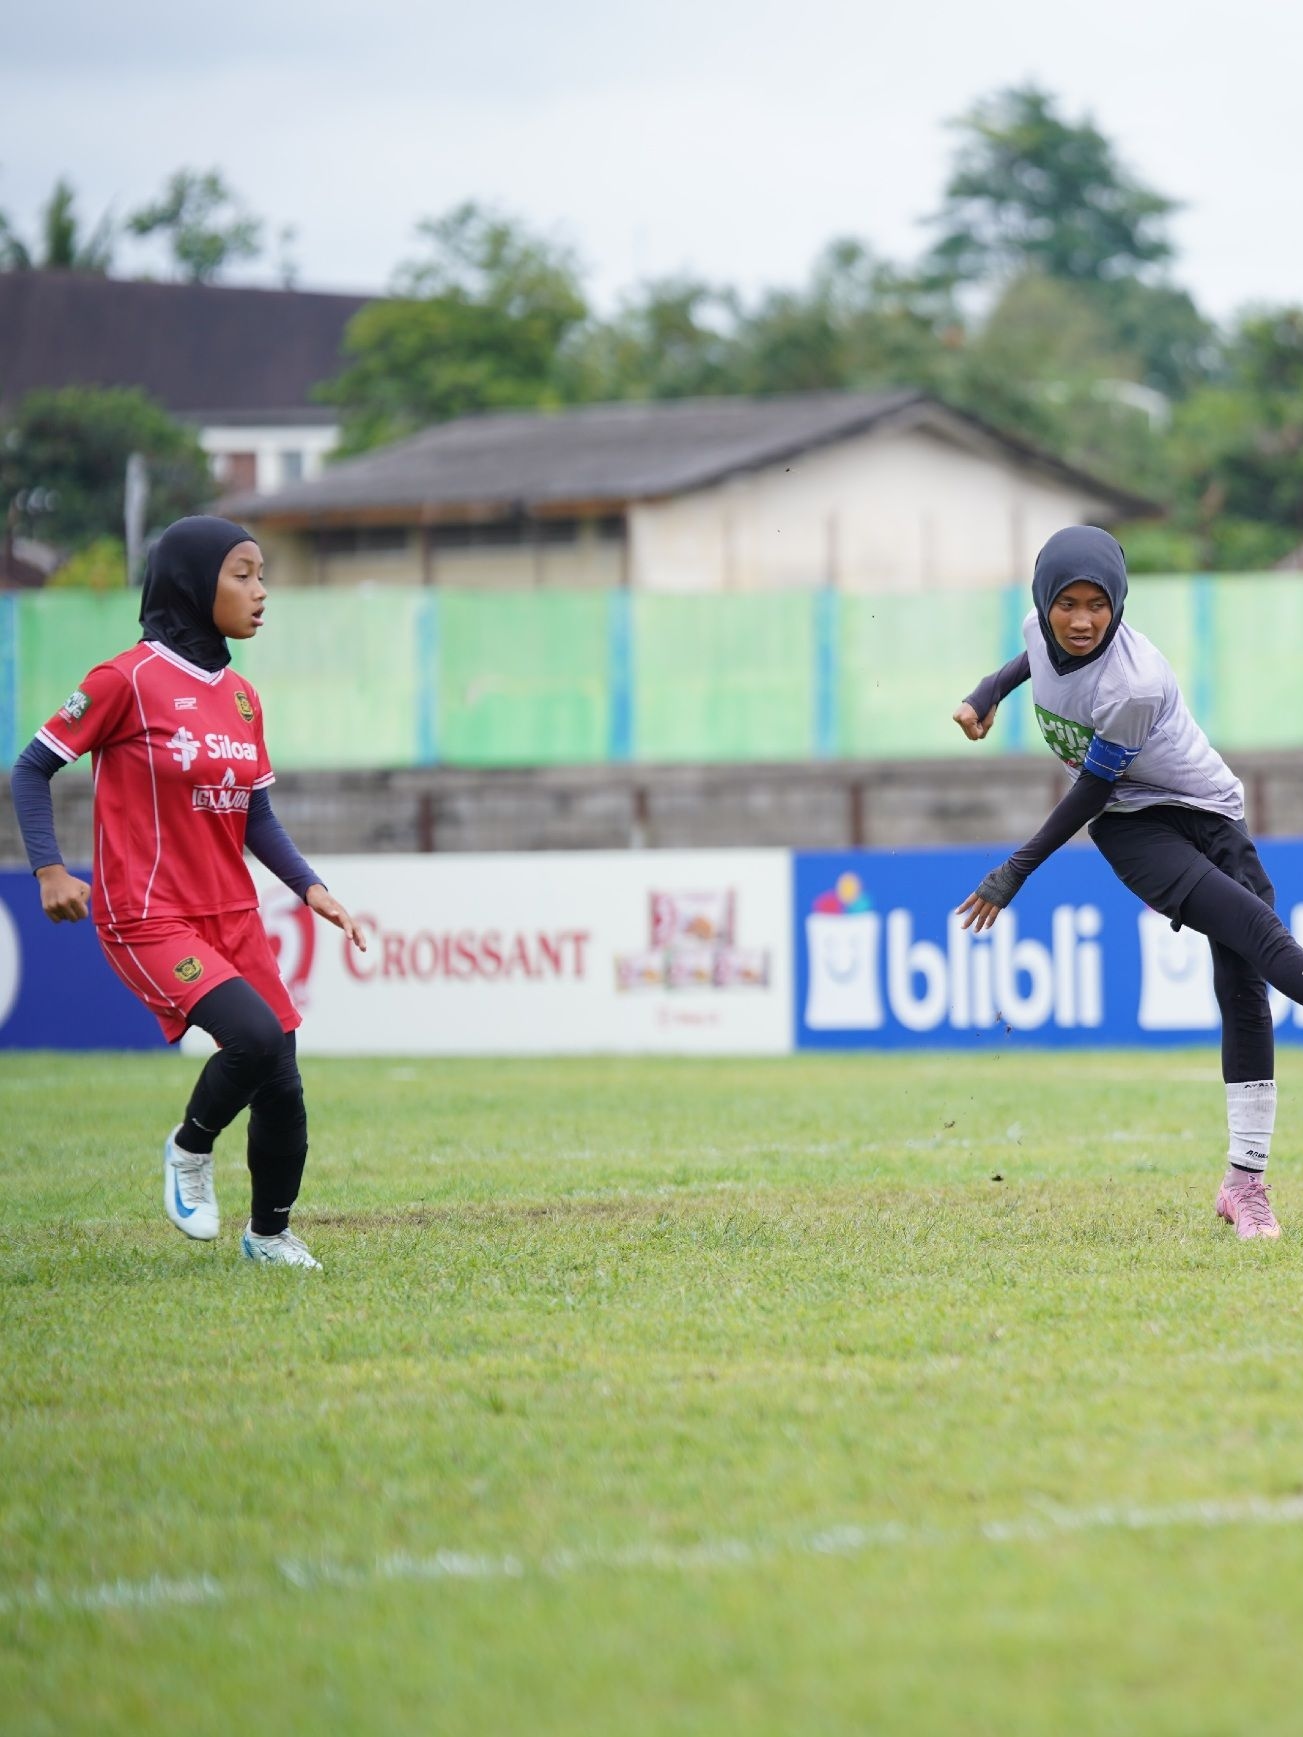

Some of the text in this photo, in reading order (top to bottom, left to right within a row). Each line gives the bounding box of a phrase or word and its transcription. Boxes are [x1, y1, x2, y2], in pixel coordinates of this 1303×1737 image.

[205, 733, 257, 761] Siloa
[341, 913, 592, 984] CROISSANT
[887, 904, 1103, 1031] blibli
